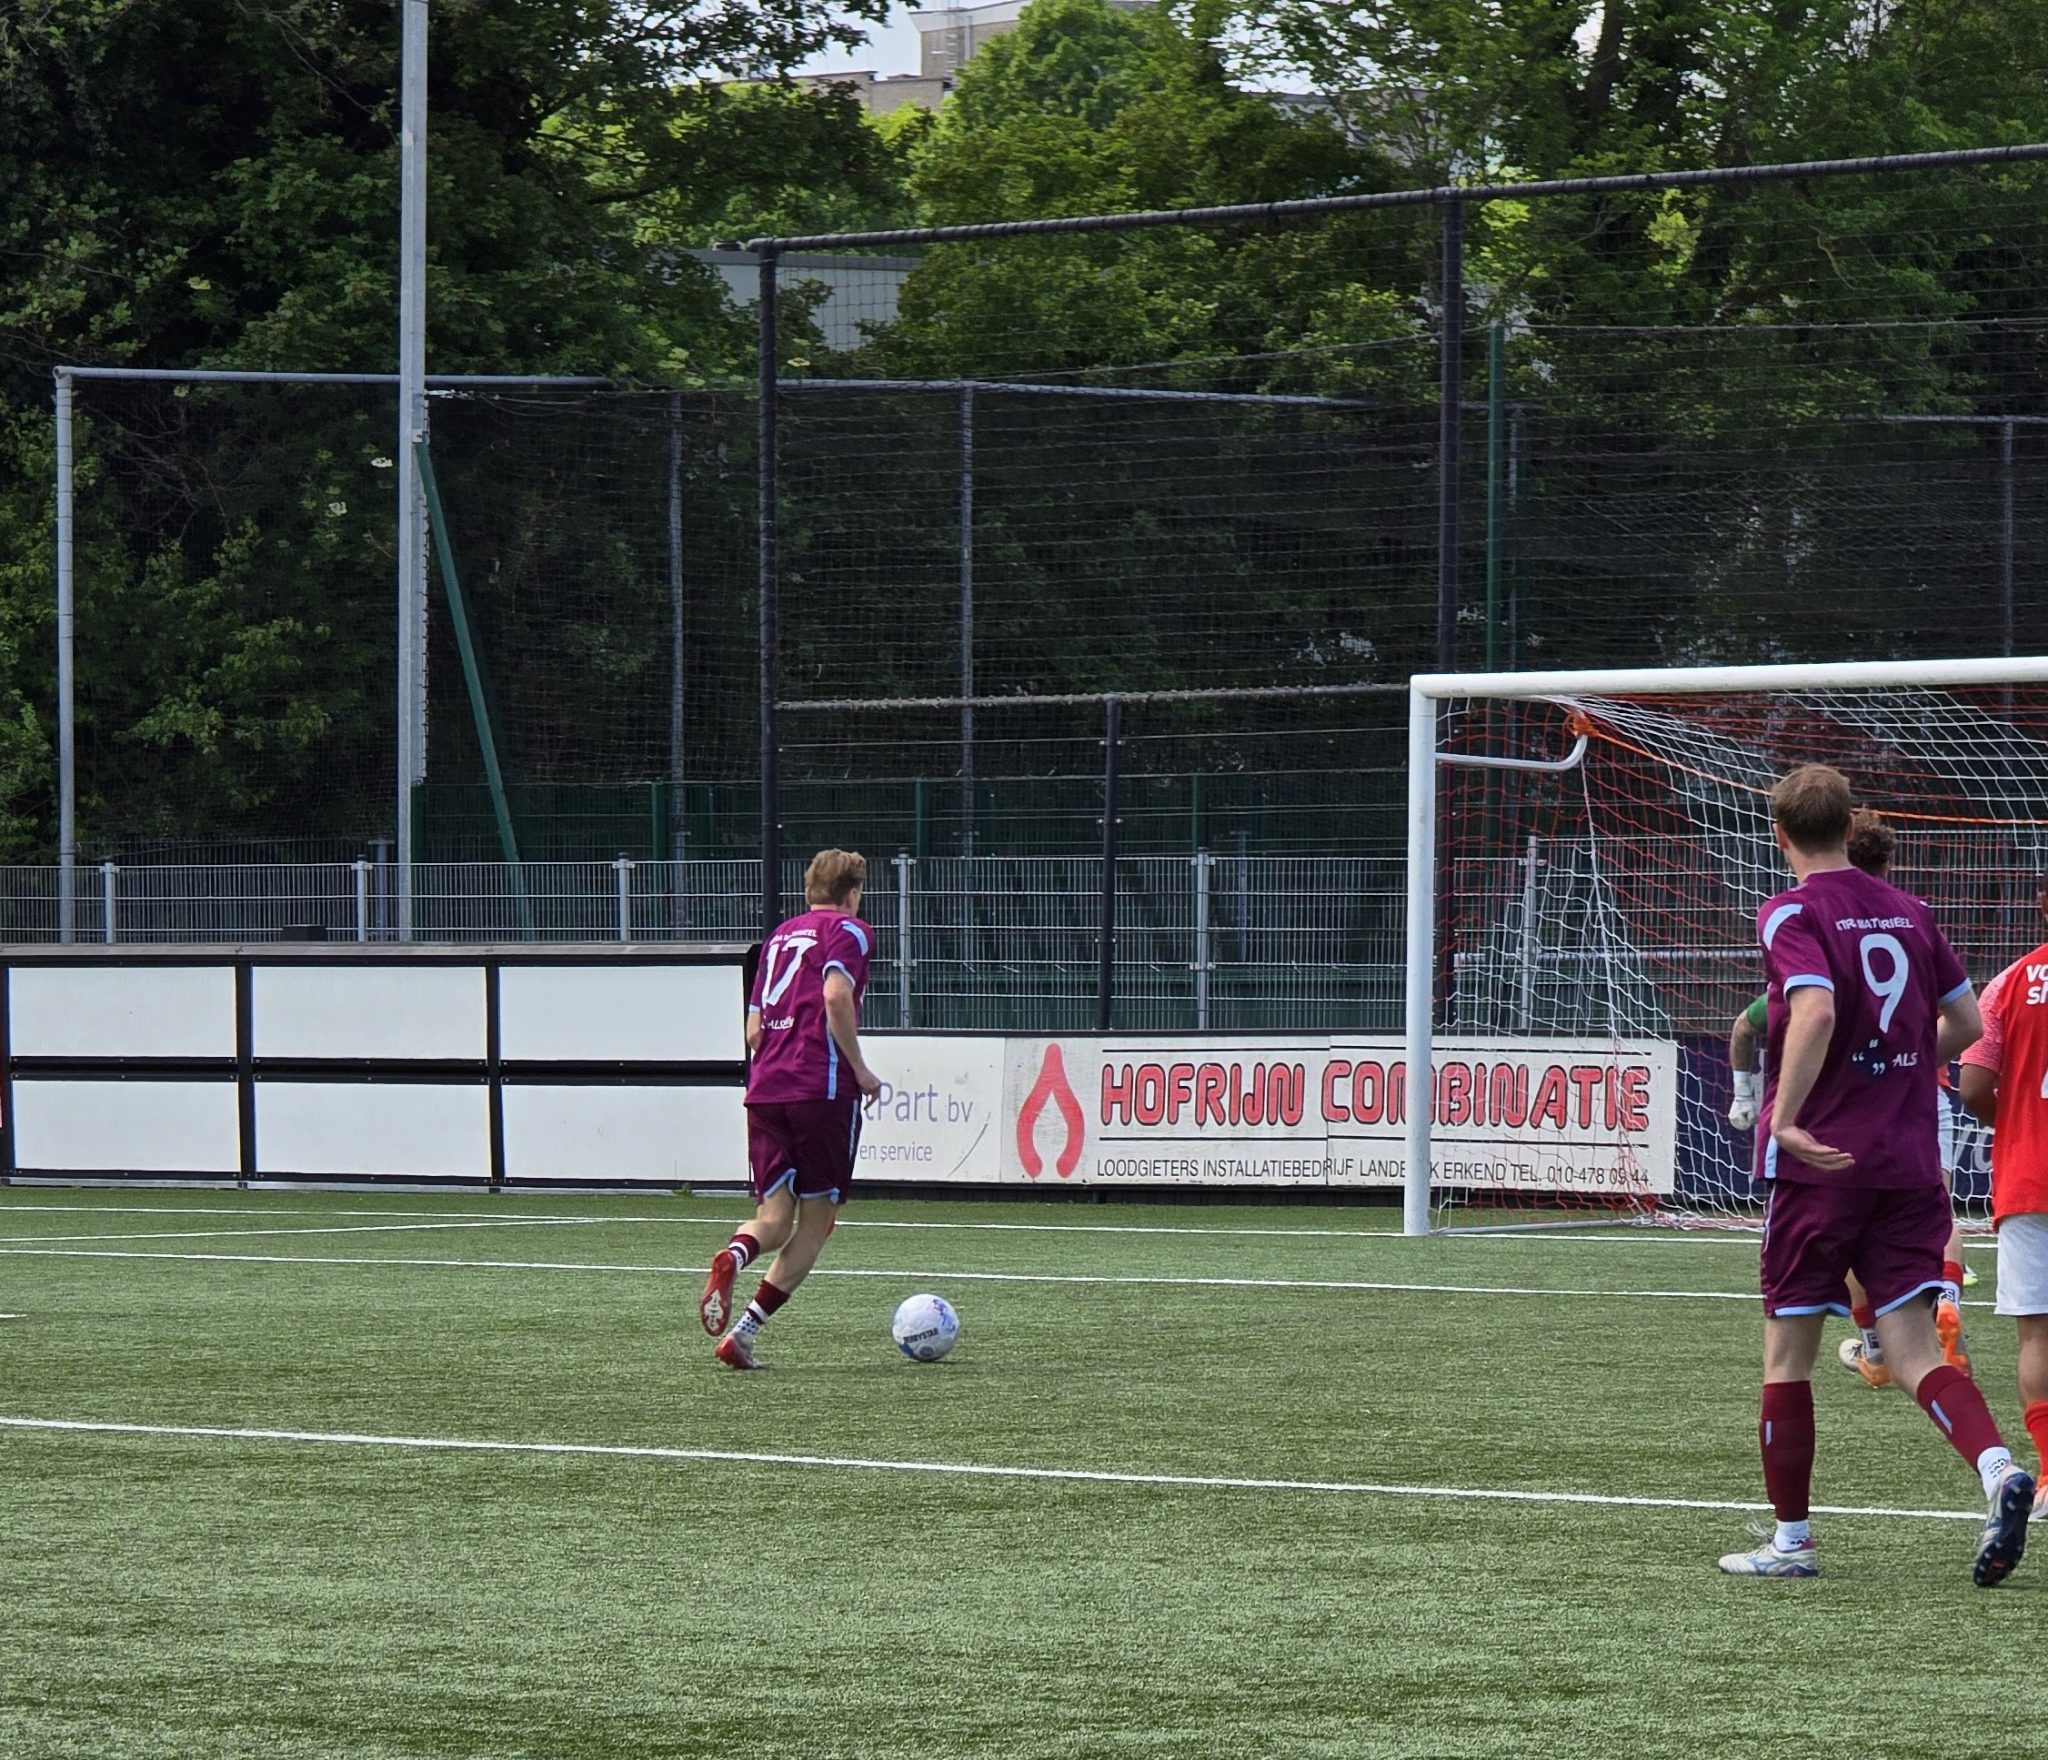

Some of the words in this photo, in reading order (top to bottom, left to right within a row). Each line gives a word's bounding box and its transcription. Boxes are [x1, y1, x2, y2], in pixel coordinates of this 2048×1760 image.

[761, 937, 818, 1010] 17
[1859, 933, 1910, 1034] 9
[1892, 1052, 1918, 1068] ALS
[947, 1093, 974, 1123] bv
[1100, 1062, 1306, 1127] HOFRIJN
[859, 1144, 877, 1160] en
[880, 1141, 933, 1162] service
[1097, 1159, 1199, 1178] LOODGIETERS
[1203, 1158, 1354, 1179] INSTALLATIEBEDRIJF
[1359, 1160, 1440, 1180] LANDEK
[1443, 1161, 1507, 1182] ERKEND
[1547, 1165, 1605, 1185] 010-478
